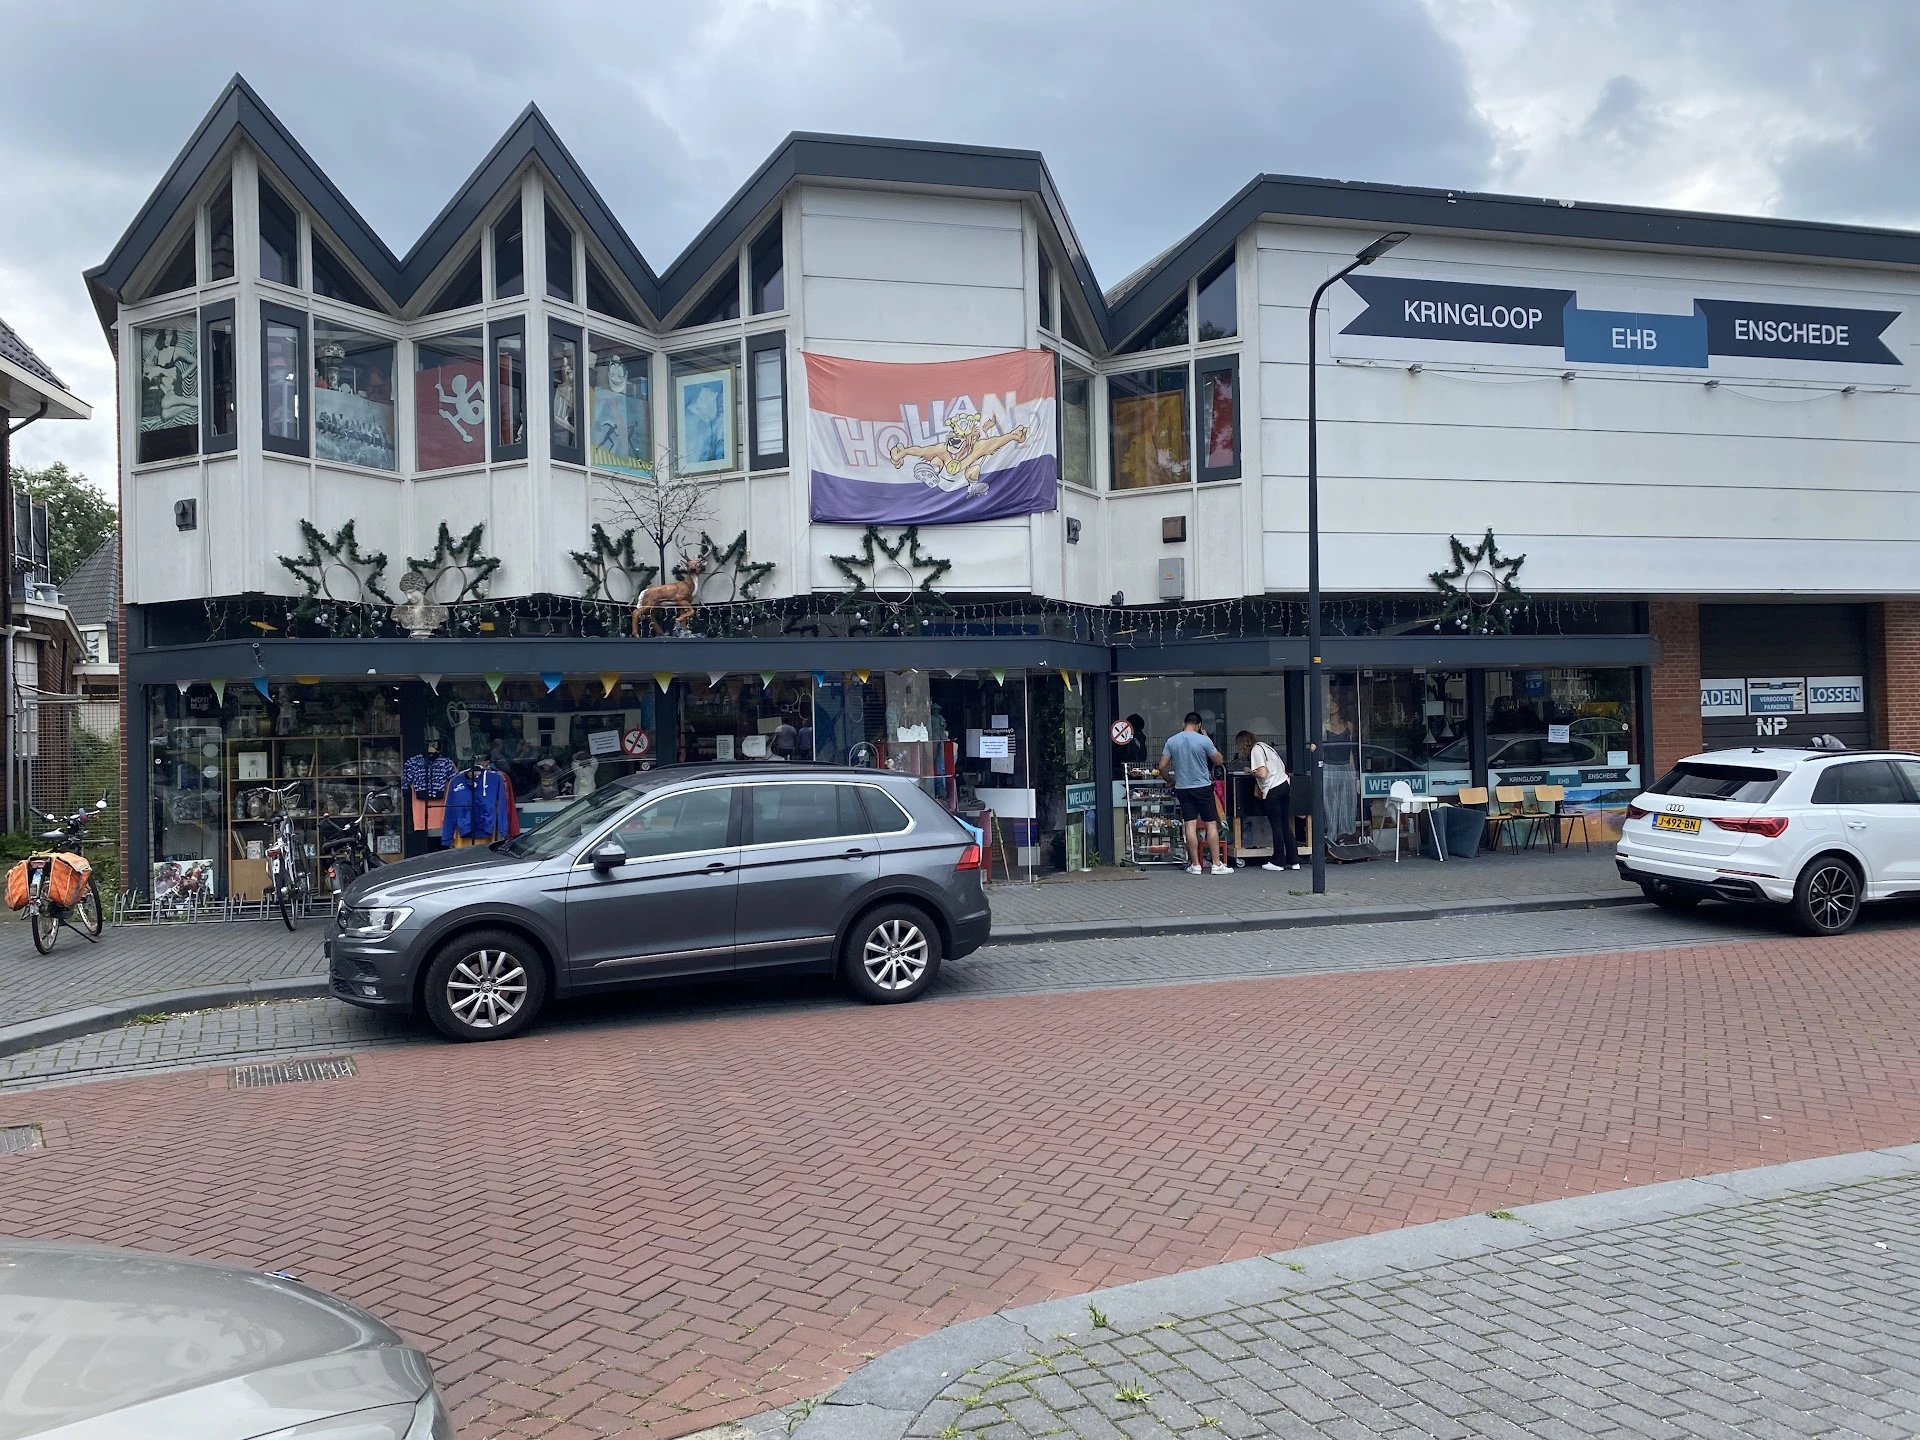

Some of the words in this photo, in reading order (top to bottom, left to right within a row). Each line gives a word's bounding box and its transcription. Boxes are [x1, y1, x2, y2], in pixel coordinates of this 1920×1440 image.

[1404, 299, 1543, 329] KRINGLOOP
[1611, 327, 1658, 350] EHB
[1734, 319, 1850, 346] ENSCHEDE
[1810, 687, 1860, 703] LOSSEN
[1756, 717, 1788, 736] NP
[1369, 779, 1422, 791] WELOM
[1509, 775, 1542, 783] KRINGLOOP
[1068, 790, 1096, 805] WELKOM
[1658, 817, 1696, 830] J-492-BN
